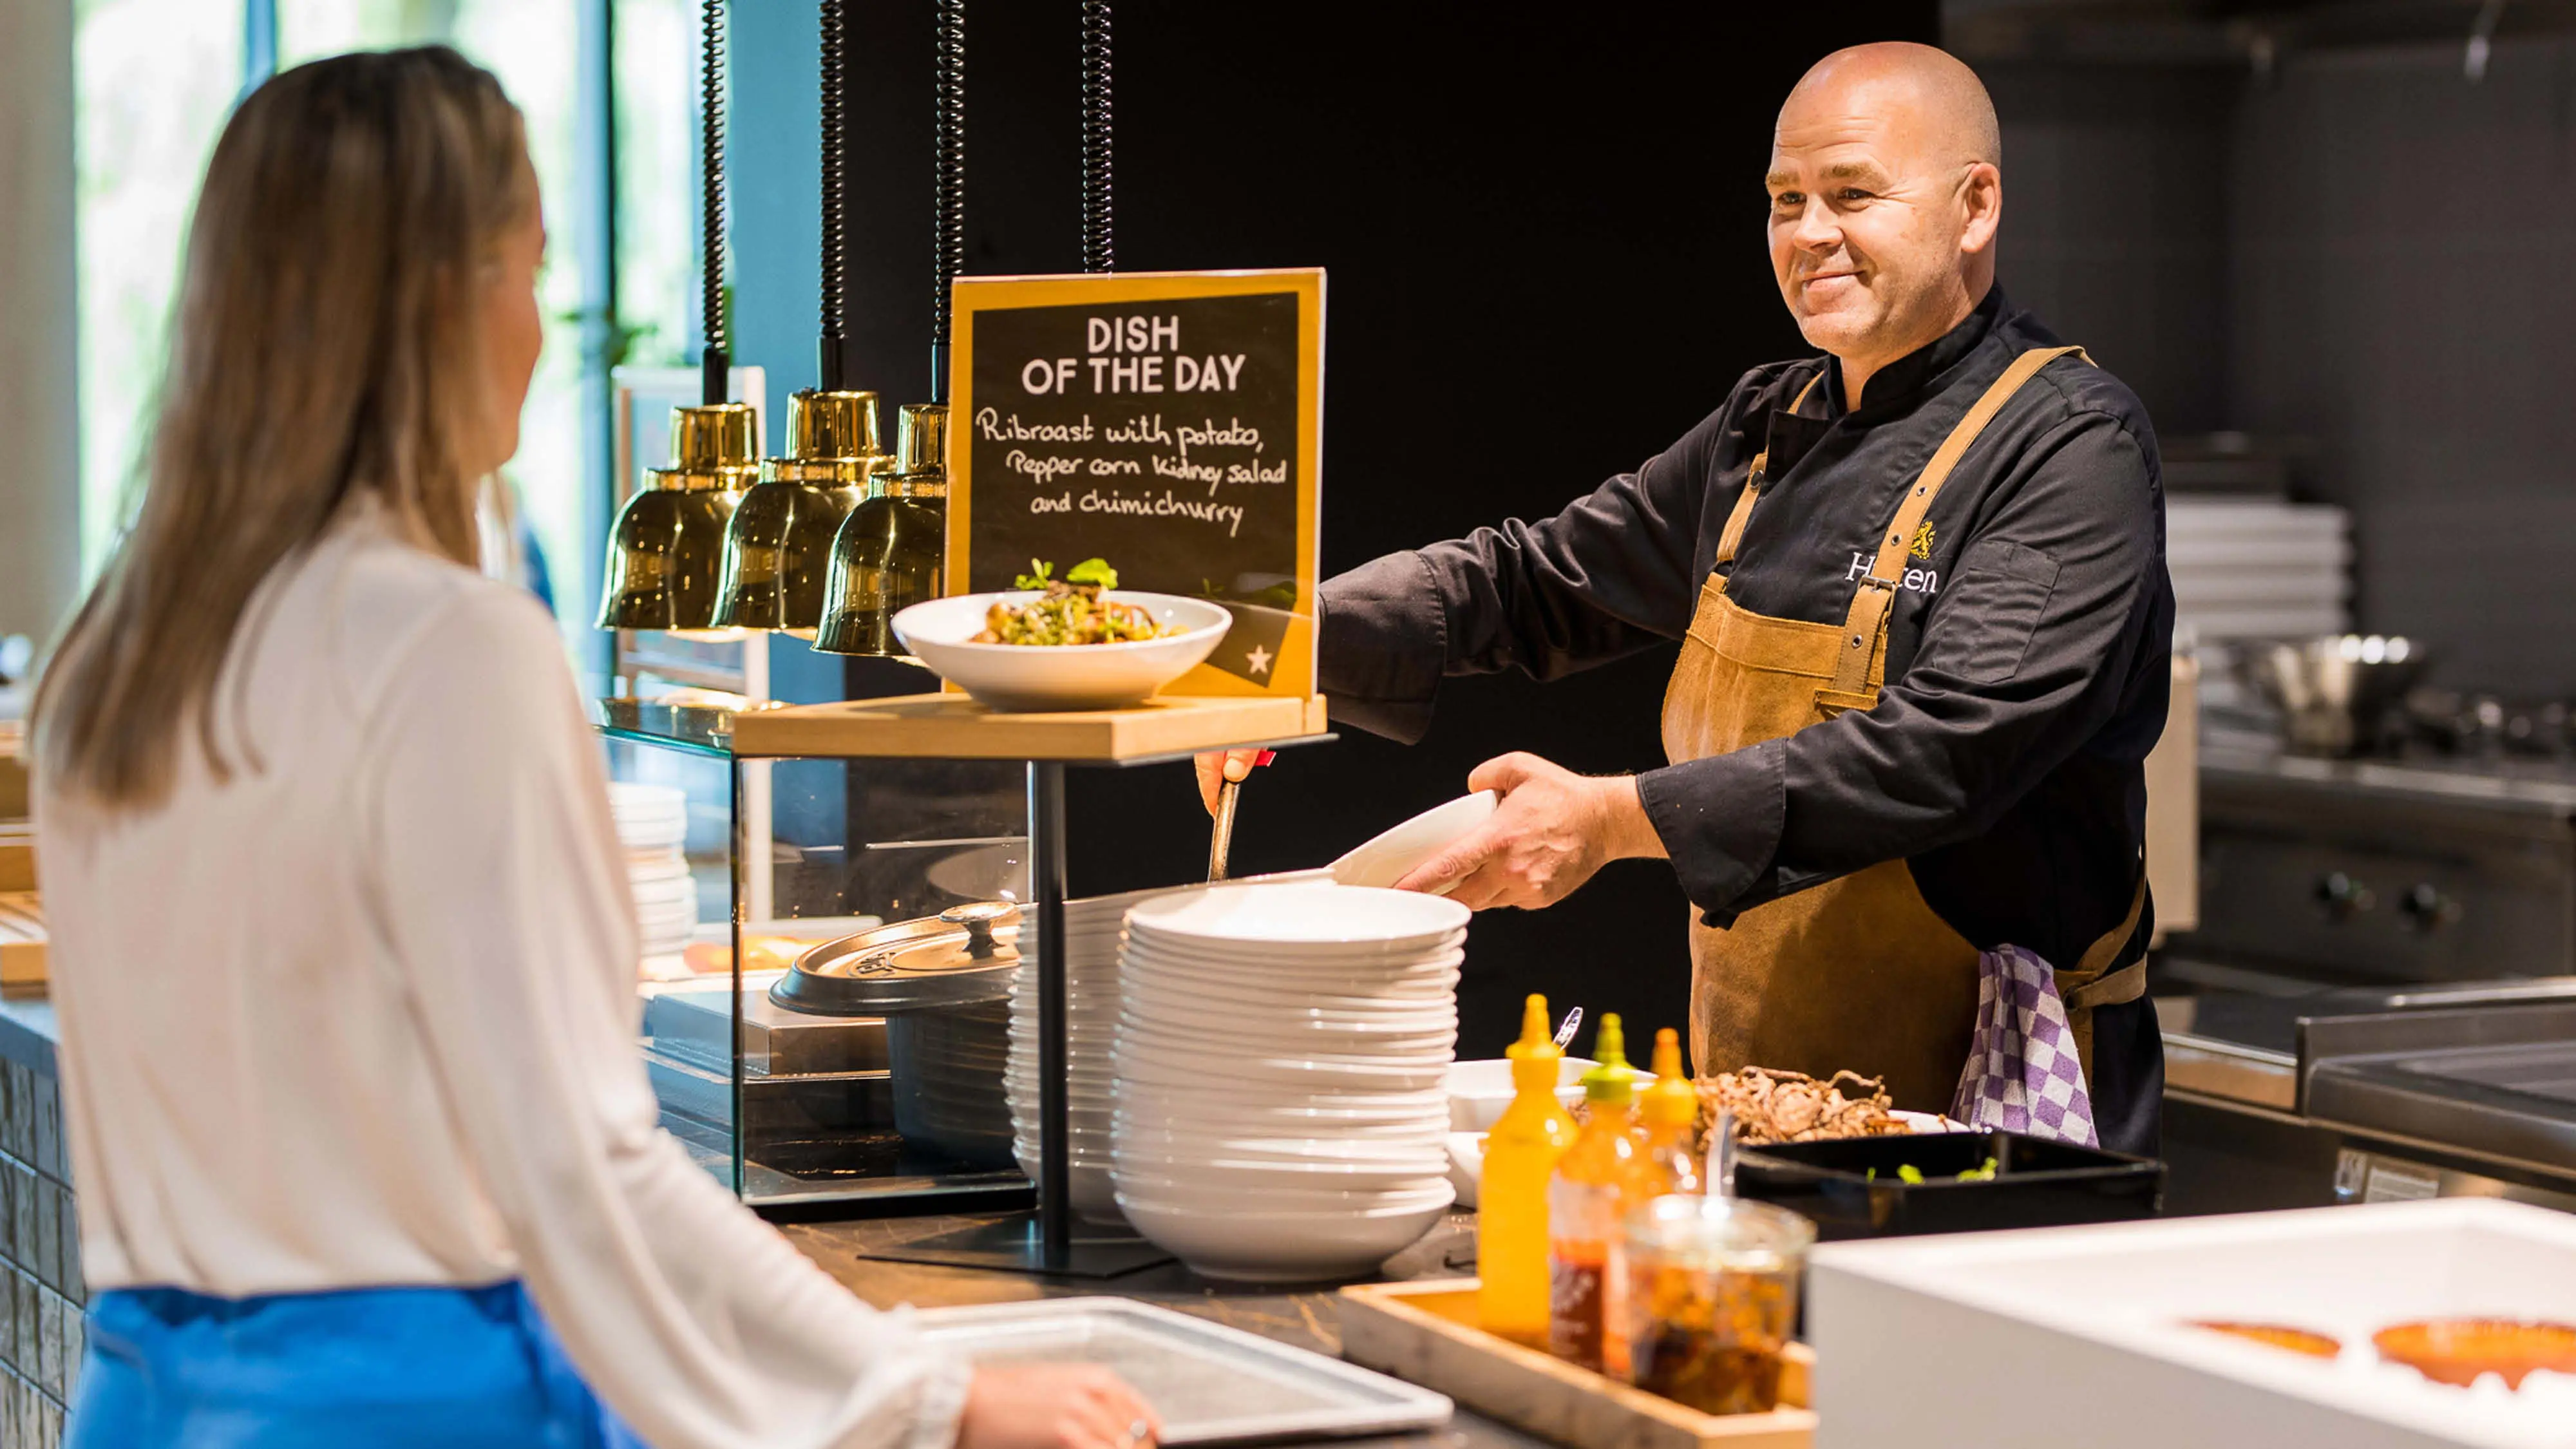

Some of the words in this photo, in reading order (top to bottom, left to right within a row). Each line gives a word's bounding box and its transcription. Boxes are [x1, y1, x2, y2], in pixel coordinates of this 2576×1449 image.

[1088, 316, 1179, 353] DISH
[1022, 359, 1077, 394] OF
[1088, 357, 1164, 393] THE
[1175, 354, 1246, 392] DAY
[976, 408, 1094, 441] Ribroast
[1106, 414, 1171, 445] with
[1177, 417, 1264, 457] potato,
[1006, 450, 1084, 484] Pepper
[1089, 458, 1141, 476] corn
[1227, 459, 1287, 484] salad
[1030, 491, 1072, 514] and
[1079, 488, 1244, 538] chimichurry
